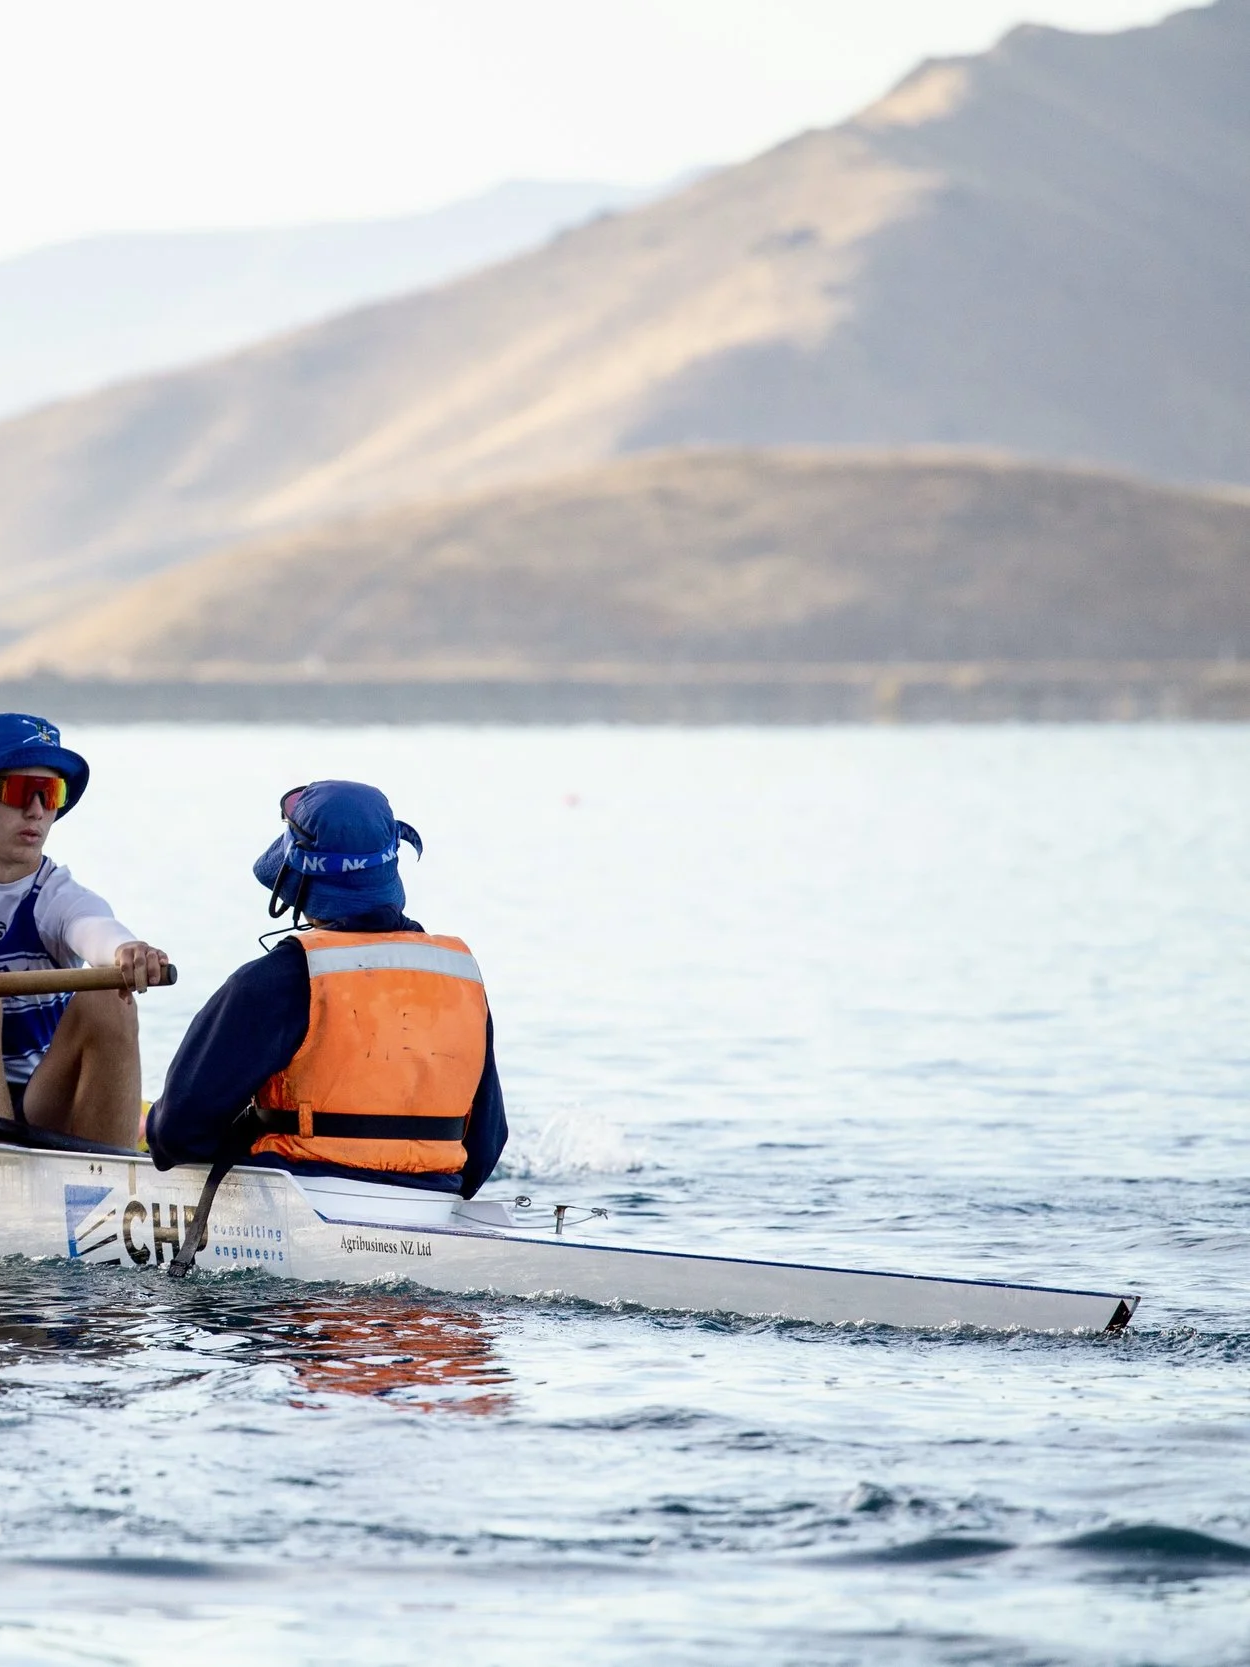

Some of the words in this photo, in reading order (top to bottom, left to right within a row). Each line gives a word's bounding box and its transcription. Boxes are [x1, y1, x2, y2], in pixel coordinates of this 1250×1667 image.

[303, 855, 327, 872] NK
[342, 858, 369, 872] NK
[213, 1224, 282, 1242] consulting
[215, 1245, 284, 1261] engineers
[340, 1234, 398, 1254] Agribusiness
[400, 1240, 415, 1255] NZ
[417, 1241, 432, 1257] Ltd
